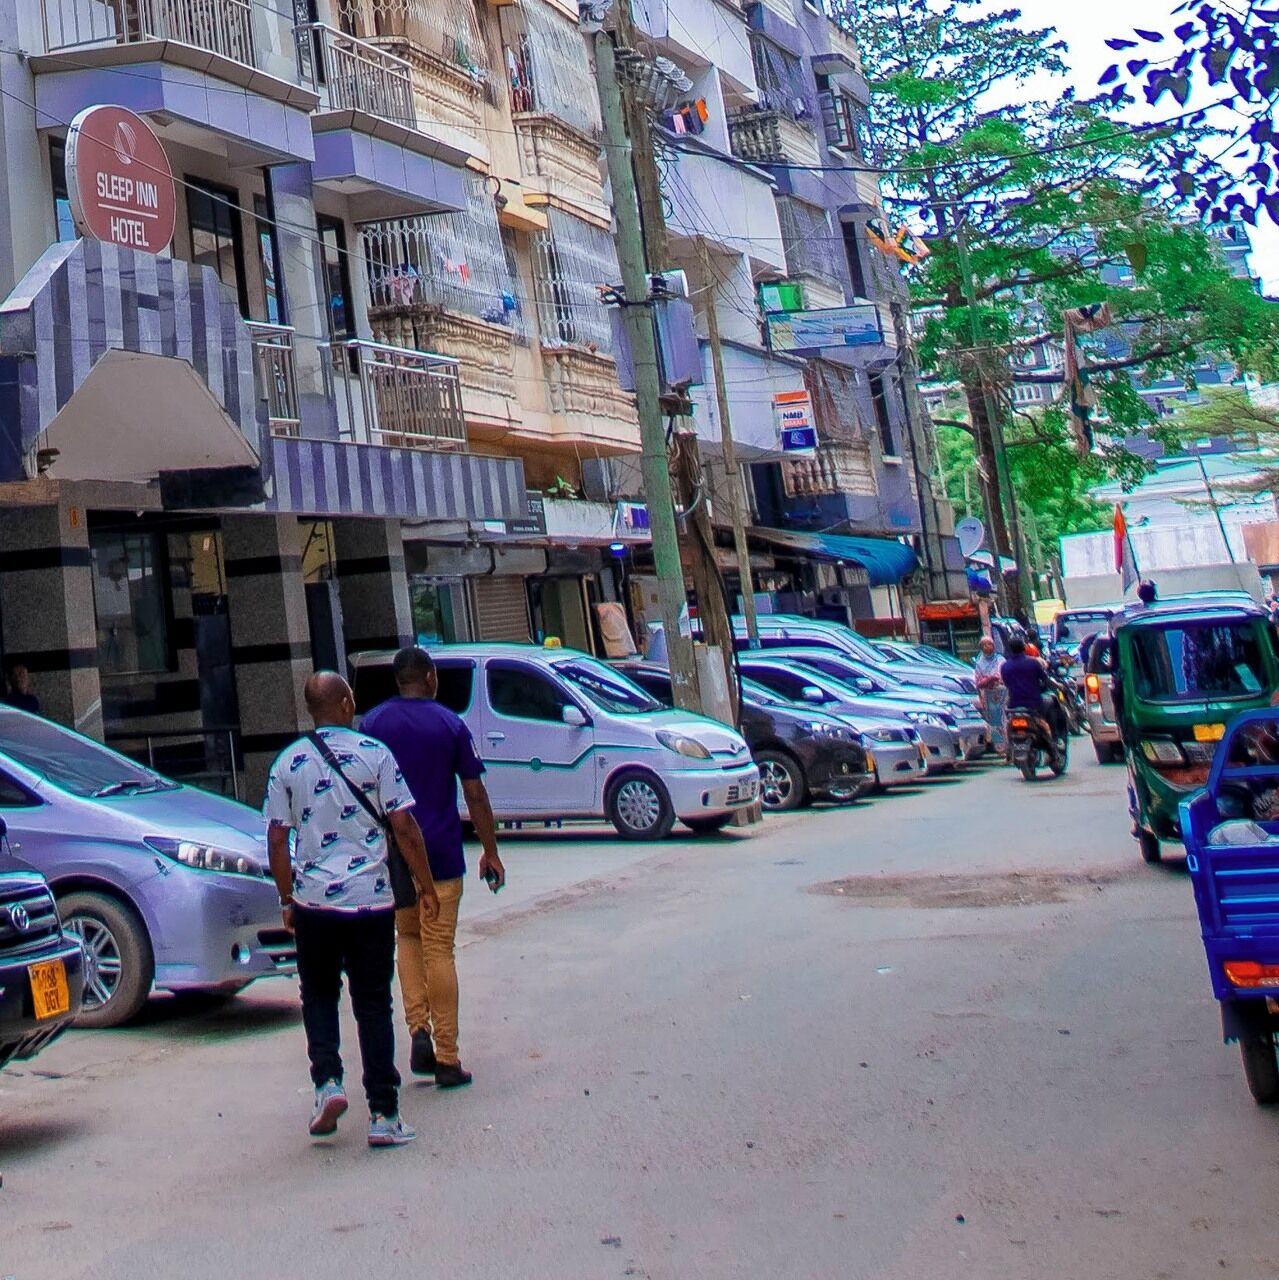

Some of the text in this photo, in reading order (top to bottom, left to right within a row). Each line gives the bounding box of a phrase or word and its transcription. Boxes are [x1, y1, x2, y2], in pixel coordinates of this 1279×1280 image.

[96, 172, 158, 208] SLEEP INN
[110, 216, 149, 246] HOTEL
[783, 411, 803, 419] NMB
